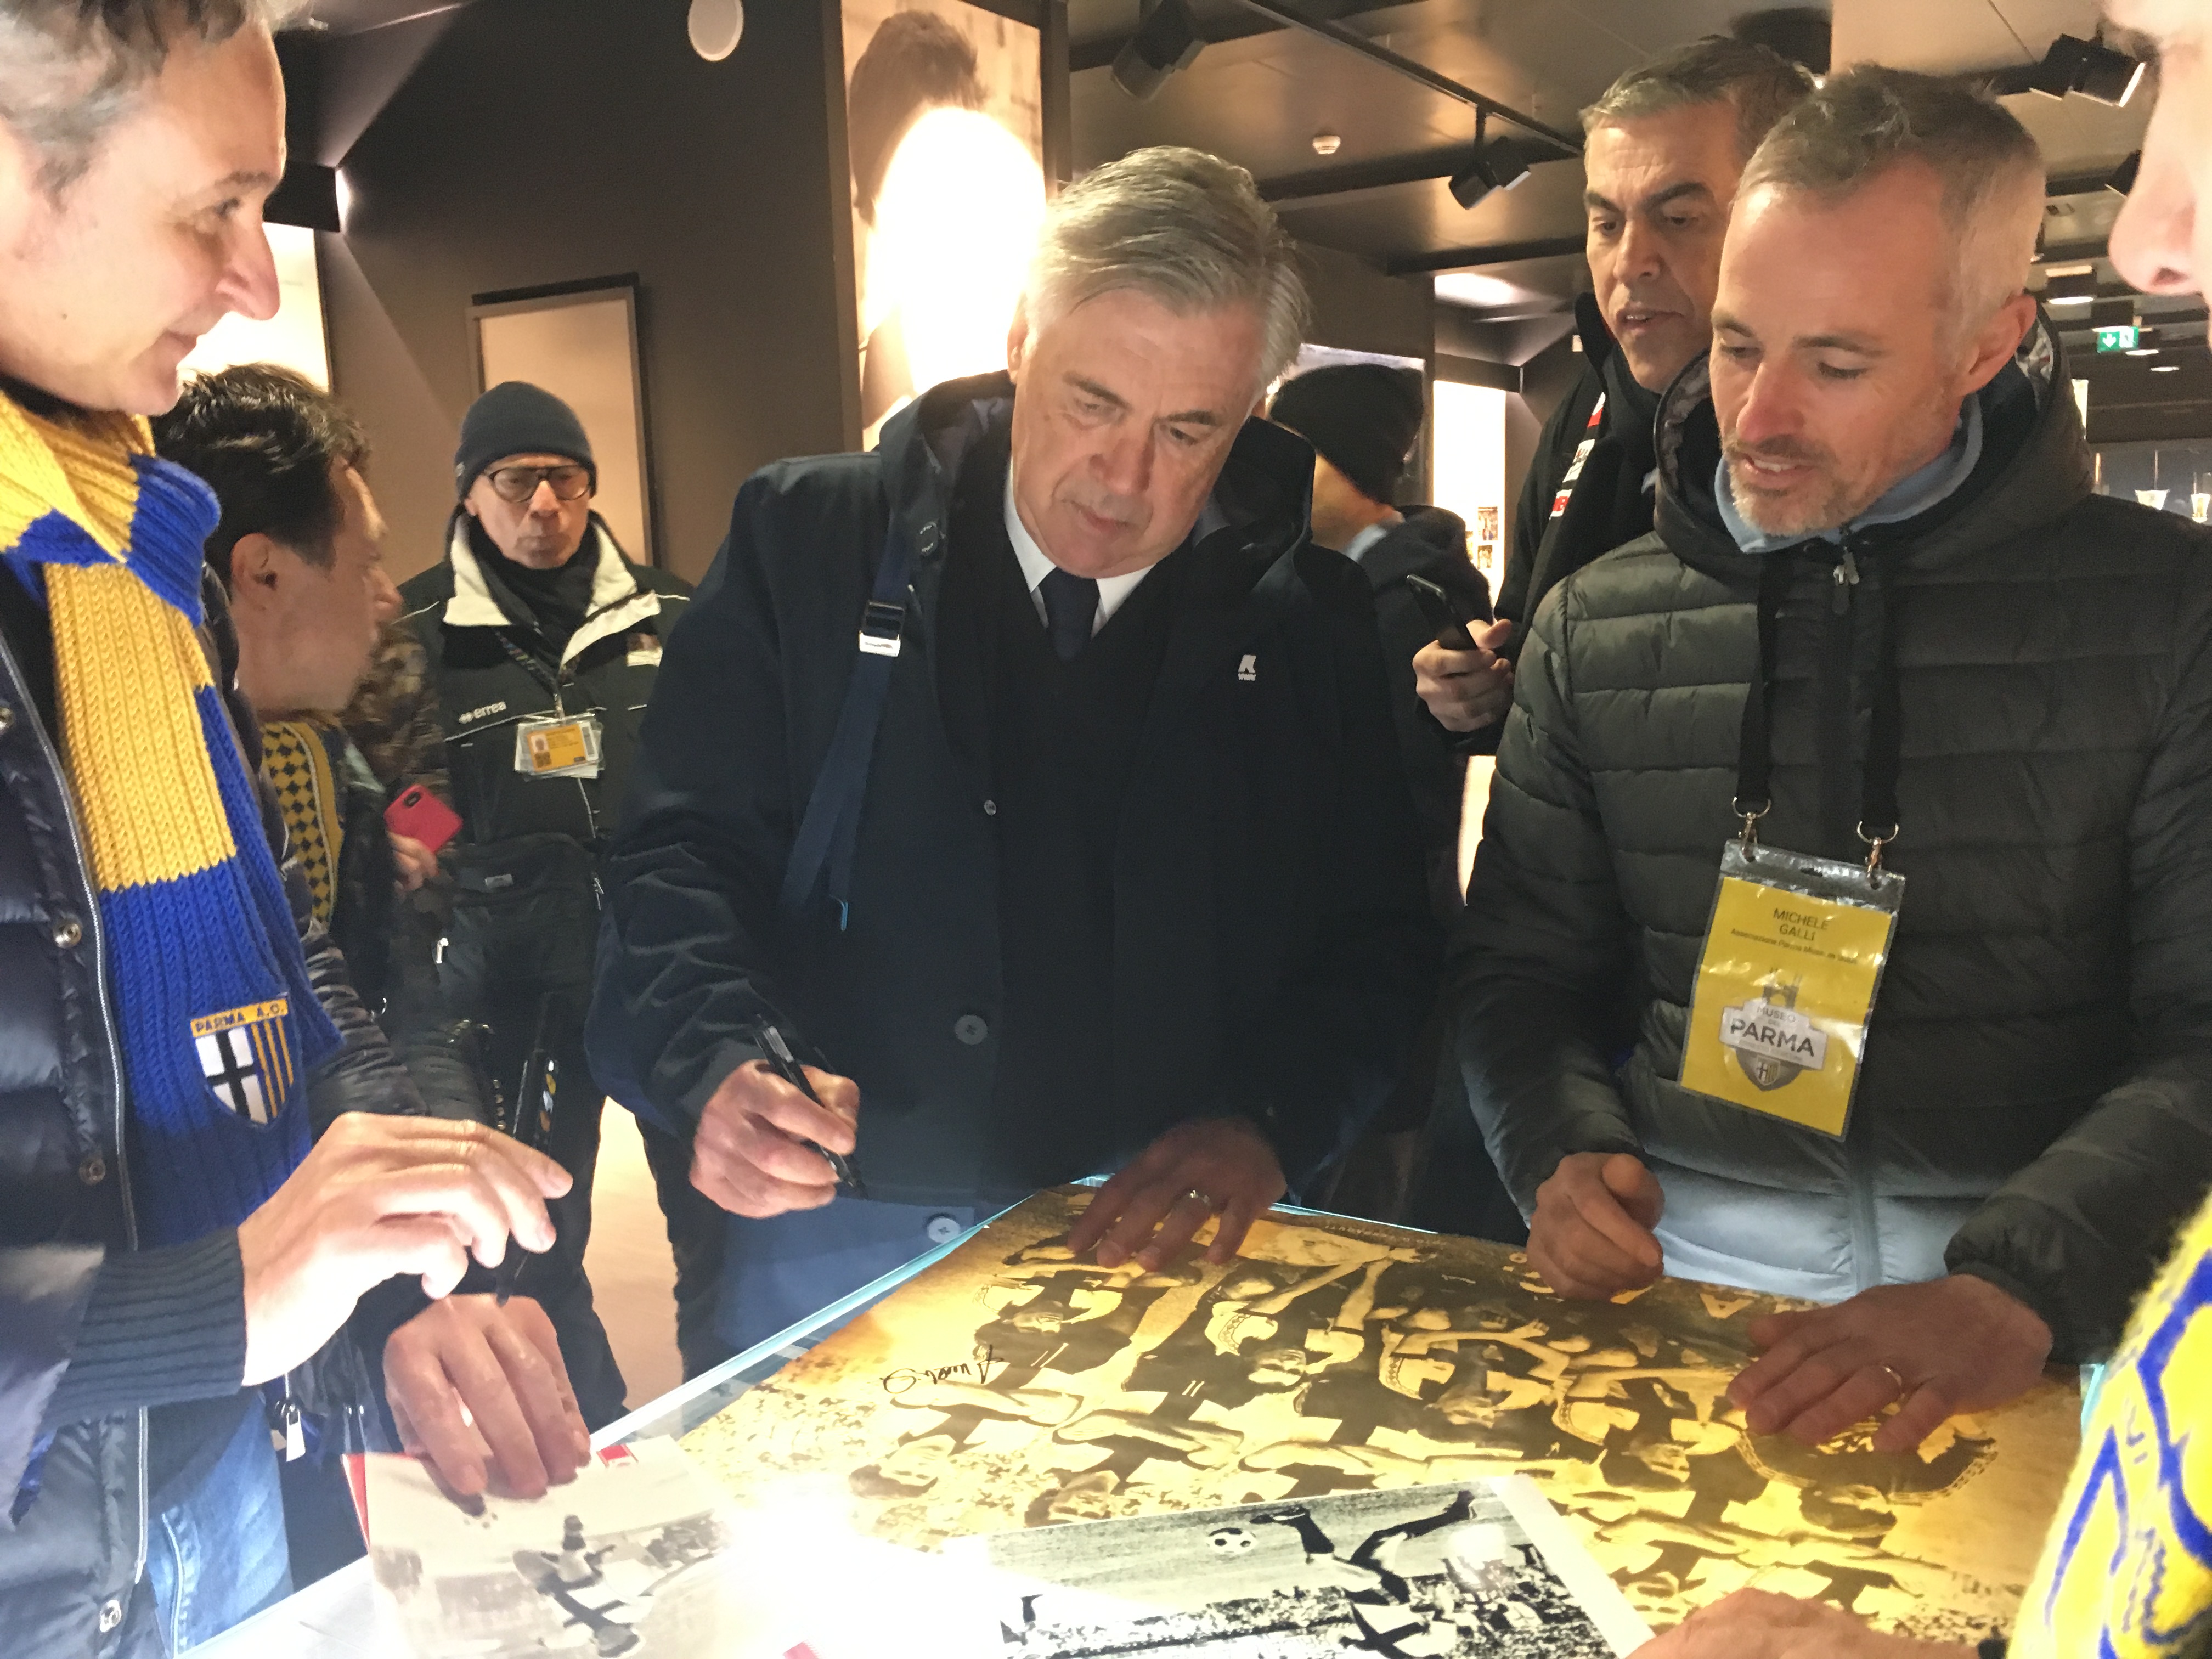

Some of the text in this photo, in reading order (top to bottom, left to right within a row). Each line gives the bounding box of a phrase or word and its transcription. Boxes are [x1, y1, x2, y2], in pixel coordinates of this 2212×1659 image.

[473, 701, 507, 719] errea
[1773, 908, 1829, 930] MICHELE
[1779, 923, 1815, 941] GALLI
[195, 1011, 245, 1032] PARMA
[1757, 1006, 1796, 1023] MUSEO
[1730, 1018, 1815, 1057] PARMA
